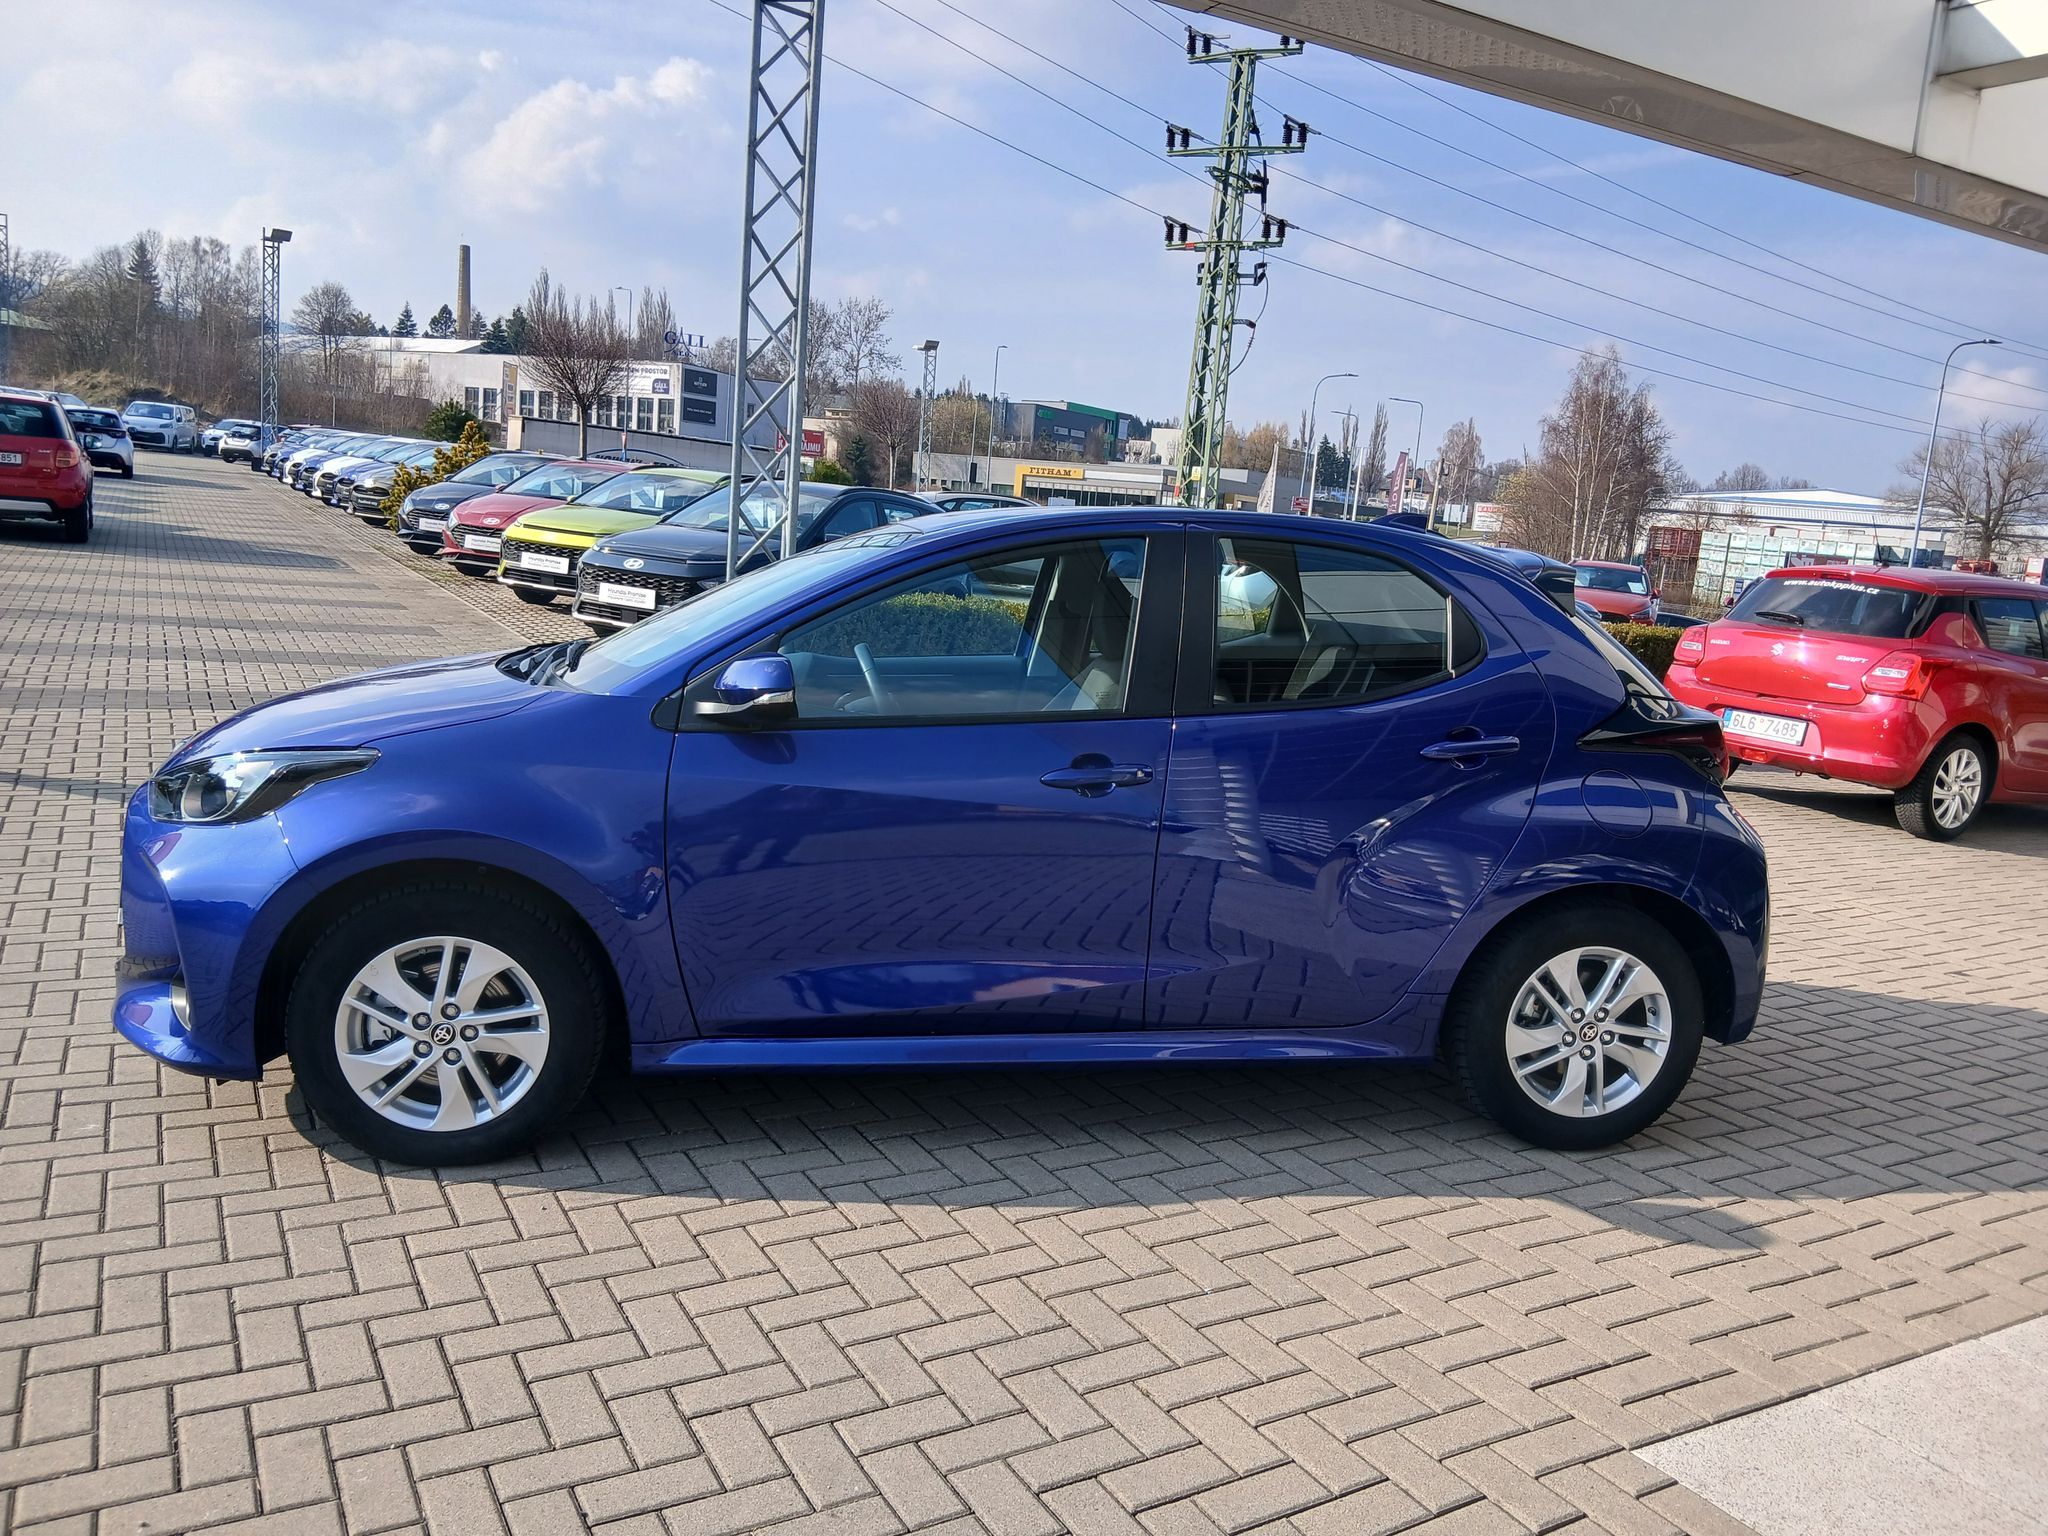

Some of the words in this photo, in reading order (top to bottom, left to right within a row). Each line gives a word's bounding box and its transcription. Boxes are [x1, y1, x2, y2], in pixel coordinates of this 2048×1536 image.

[664, 327, 709, 357] GALL
[1029, 466, 1072, 477] FITHAM
[1783, 579, 1880, 595] www.autokpplus.cz
[1835, 654, 1869, 664] SWIFT
[1732, 713, 1756, 731] 6L6
[1763, 719, 1800, 739] 7485
